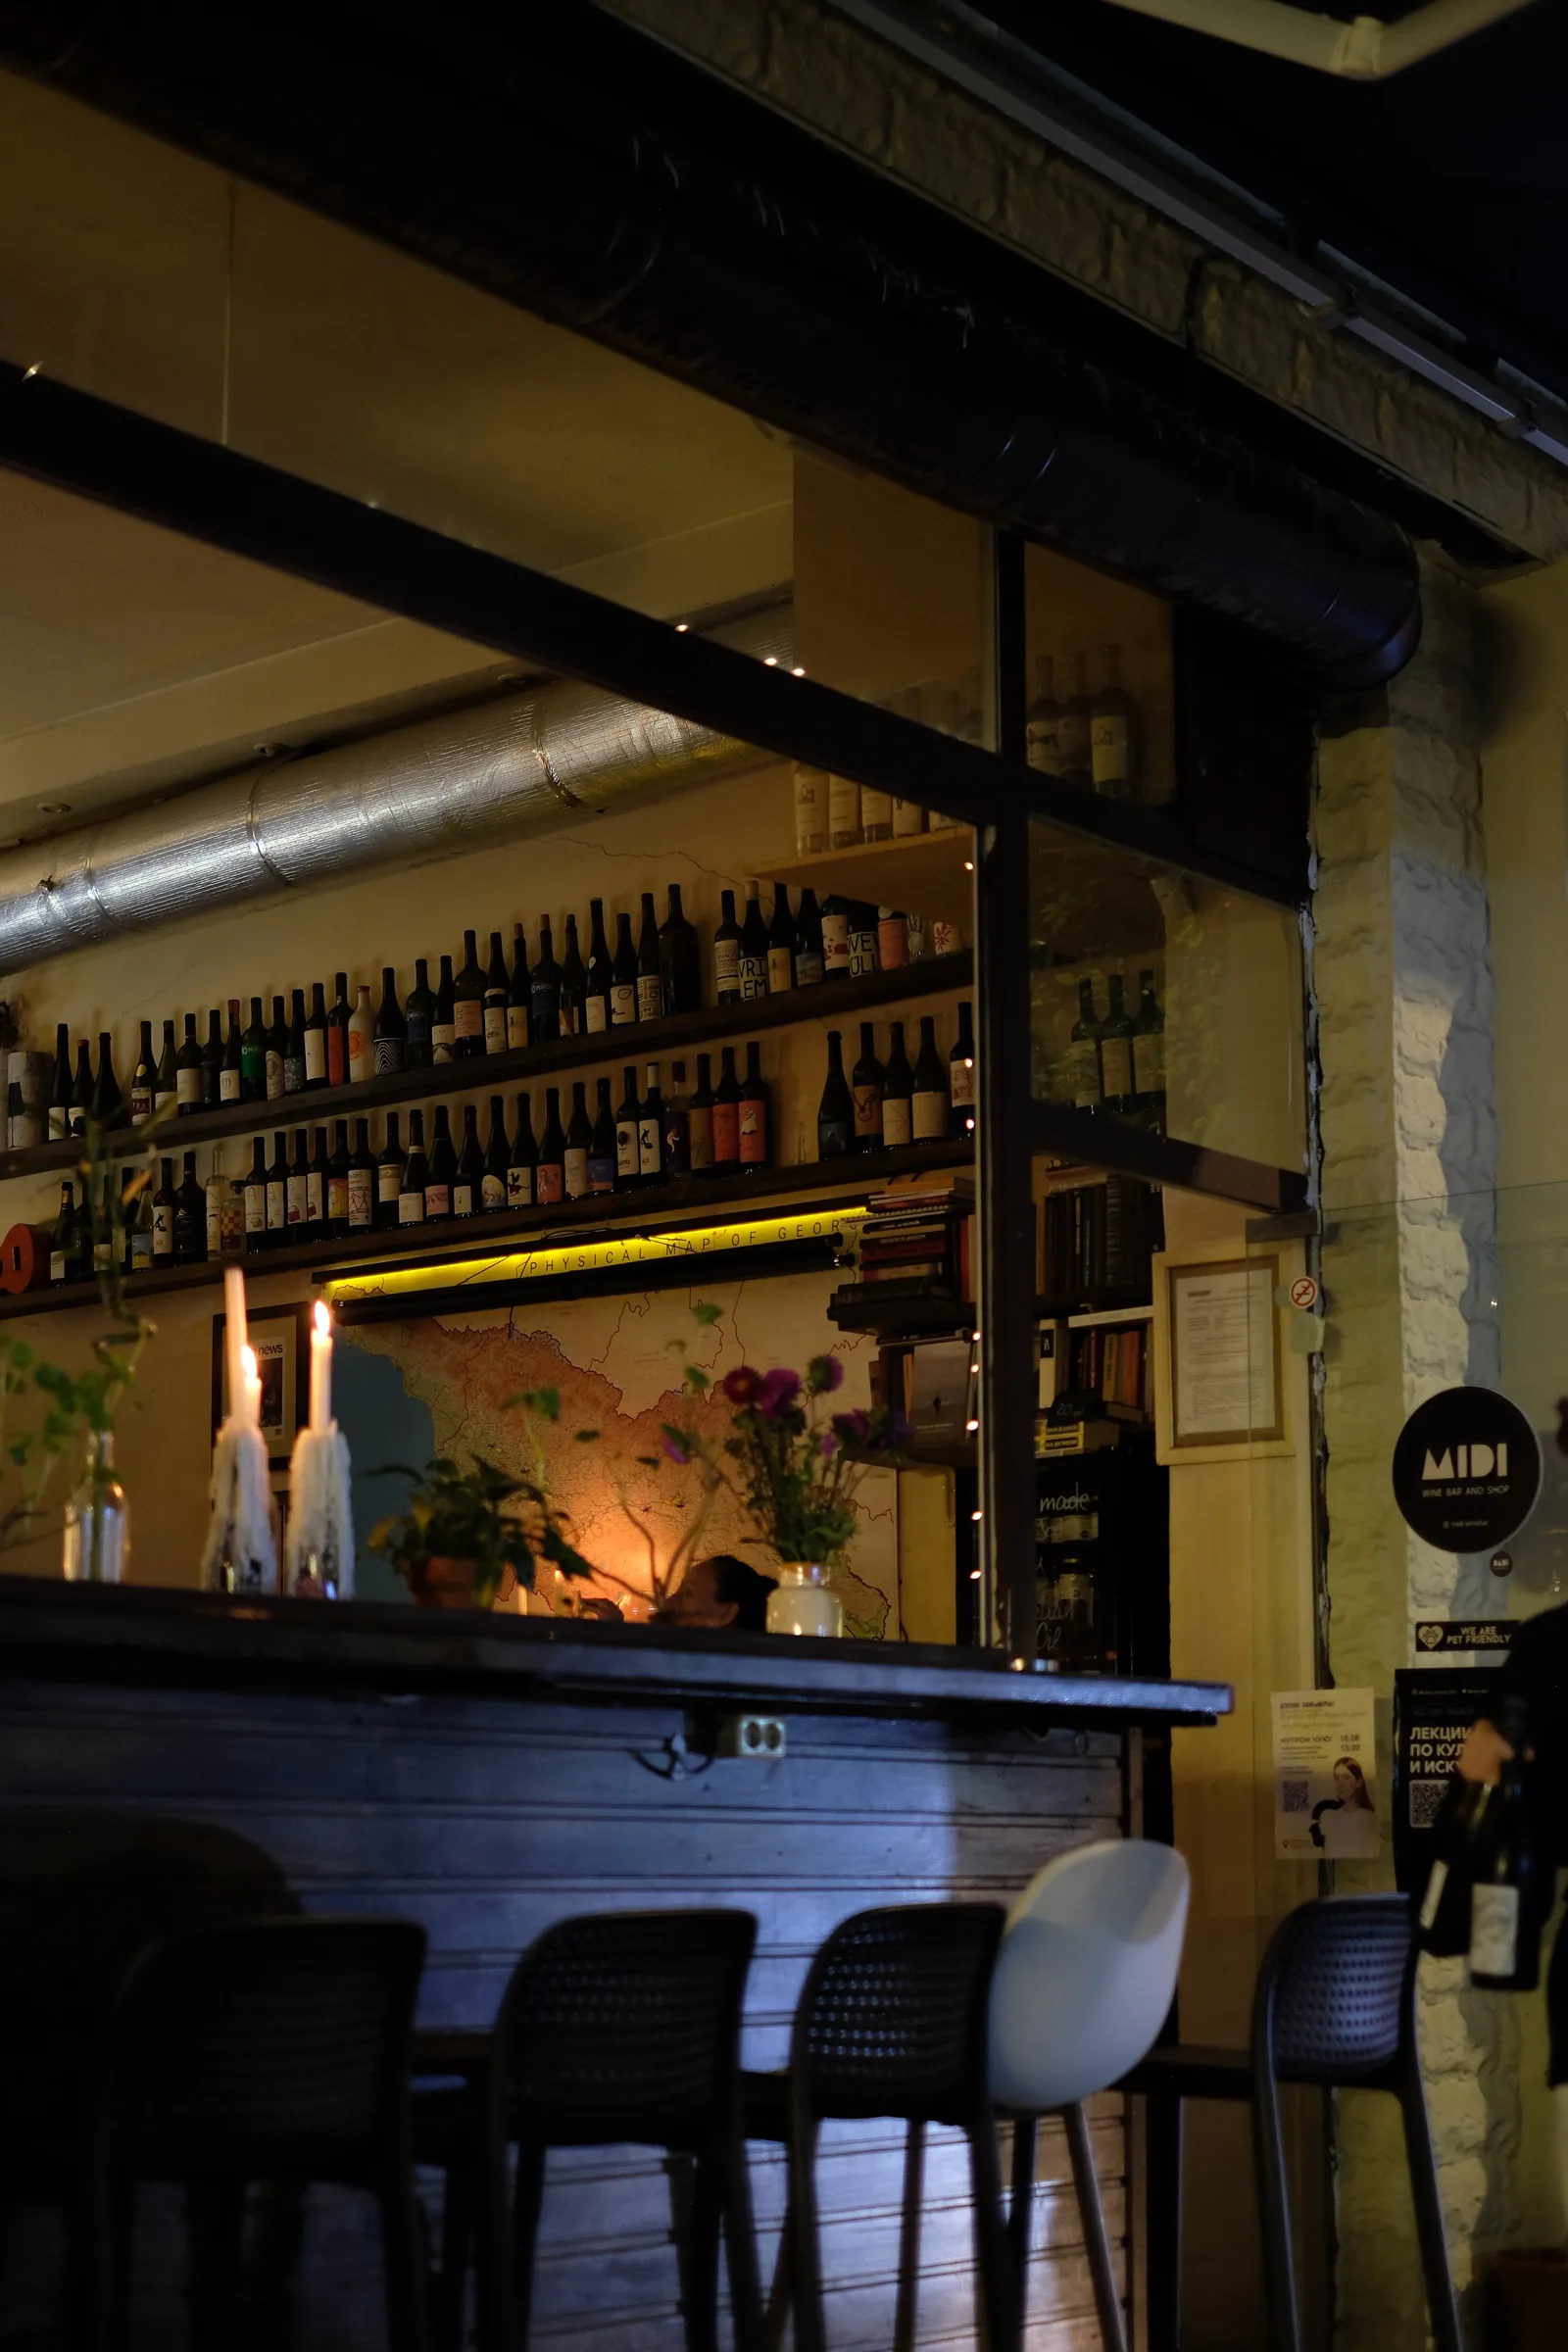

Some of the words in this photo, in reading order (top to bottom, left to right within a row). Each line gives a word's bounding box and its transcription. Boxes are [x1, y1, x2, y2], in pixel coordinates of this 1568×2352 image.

[258, 364, 283, 375] news
[741, 979, 767, 1000] EM
[529, 1248, 646, 1273] PHYSICAL
[665, 1238, 710, 1255] MAP
[731, 1231, 757, 1247] OF
[778, 1219, 858, 1240] GEOR
[1421, 1443, 1508, 1481] MIDI
[1039, 1482, 1090, 1514] made
[1422, 1488, 1443, 1498] WINE
[1446, 1487, 1462, 1497] BAR
[1465, 1486, 1484, 1495] AND
[1487, 1485, 1511, 1494] SHOP
[1459, 1627, 1477, 1636] WE
[1479, 1626, 1497, 1635] ARE
[1446, 1635, 1463, 1644] PET
[1465, 1634, 1511, 1644] FRIENDLY
[1409, 1743, 1433, 1757] ПО
[1436, 1743, 1465, 1757] КУЛ
[1409, 1760, 1421, 1774] И
[1424, 1759, 1457, 1774] ИСК
